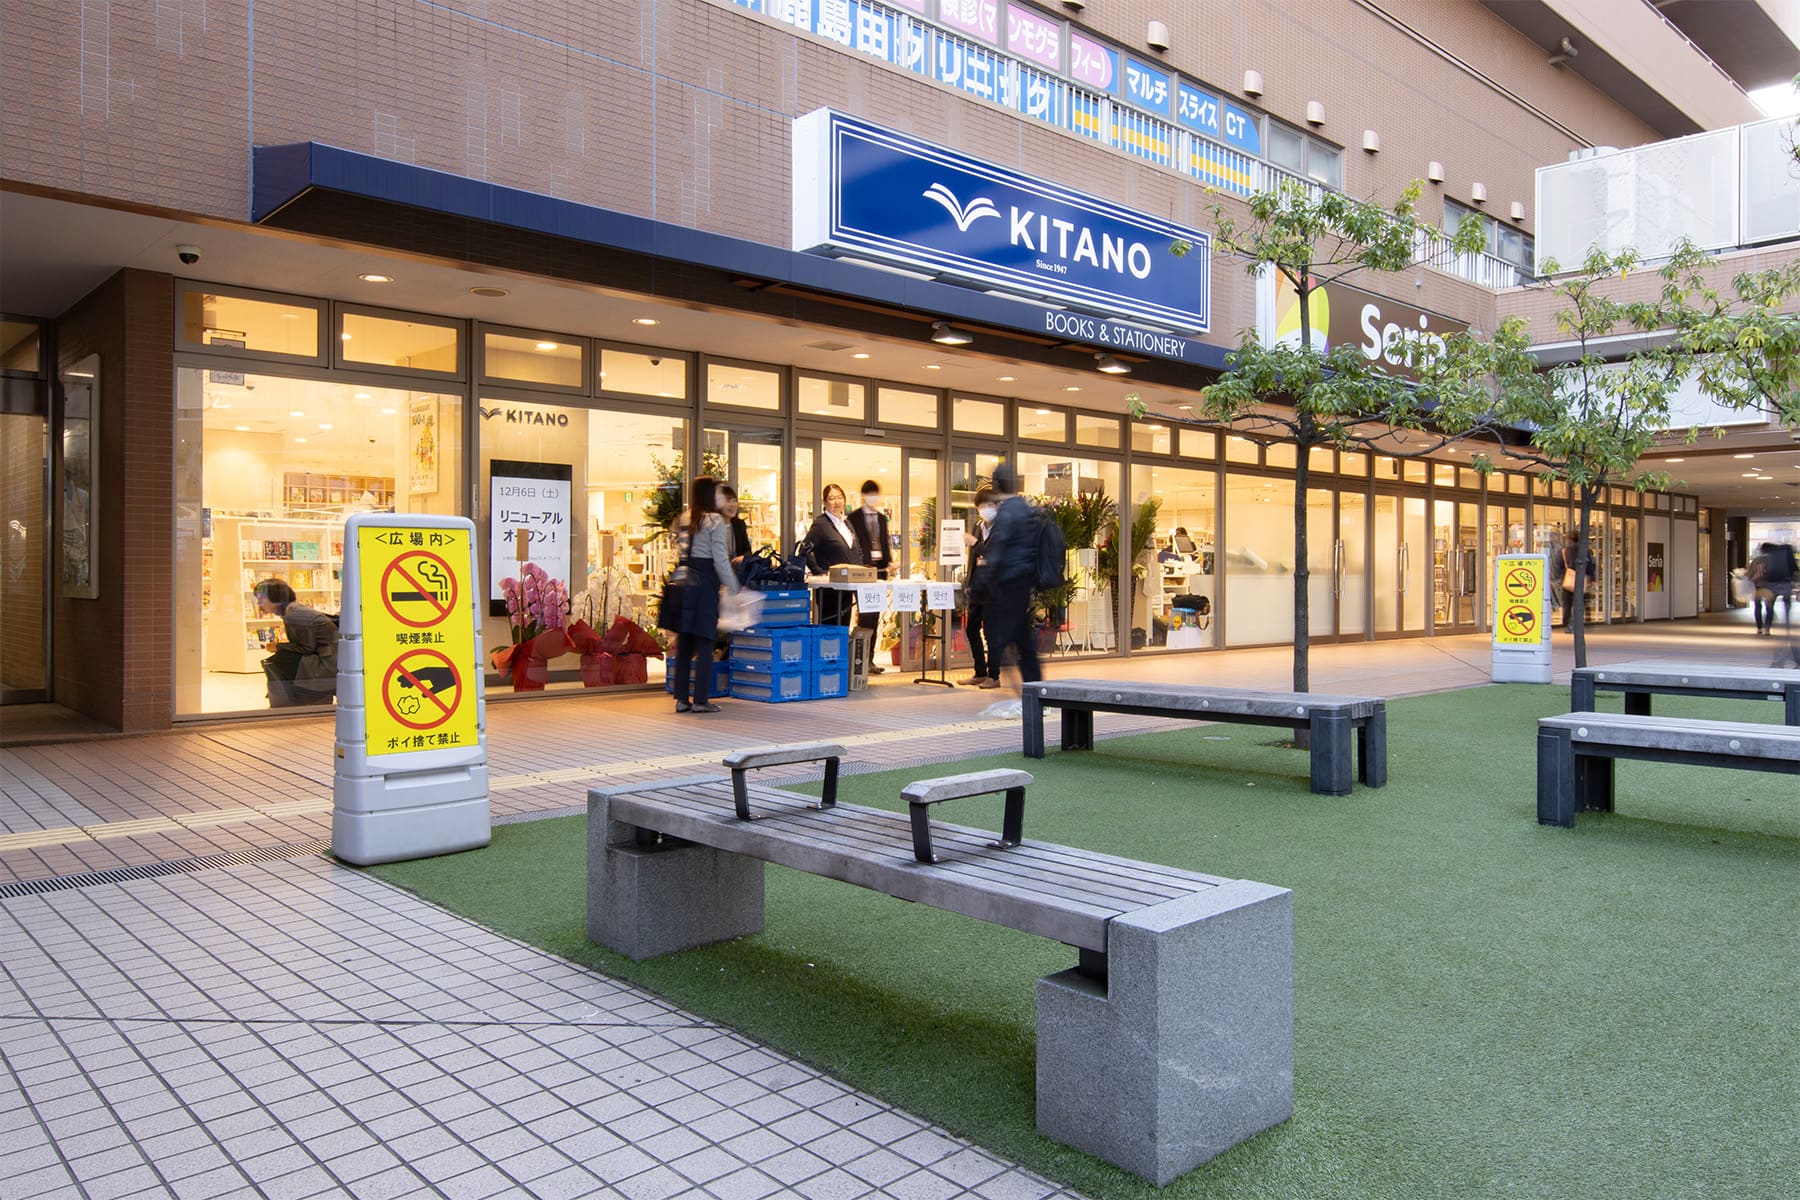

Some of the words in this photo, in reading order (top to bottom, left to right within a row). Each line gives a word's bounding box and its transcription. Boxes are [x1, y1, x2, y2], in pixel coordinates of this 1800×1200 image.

[1127, 67, 1168, 105] マルチ
[1179, 90, 1218, 130] スライス
[1226, 112, 1246, 140] CT
[1010, 206, 1151, 279] KITANO
[1036, 259, 1053, 271] Since
[1054, 261, 1067, 274] 1947
[1046, 312, 1094, 339] BOOKS
[1100, 325, 1110, 342] &
[1113, 326, 1186, 357] STATIONERY
[506, 409, 569, 427] KITANO
[500, 487, 560, 499] 12月6日（土）
[500, 510, 563, 525] リニューアル
[503, 529, 555, 543] オプン！
[865, 592, 881, 603] 受付
[898, 592, 914, 603] 受付
[933, 590, 948, 601] 受付
[396, 632, 445, 645] 喫煙禁止
[387, 731, 461, 749] ポイ捨て禁止
